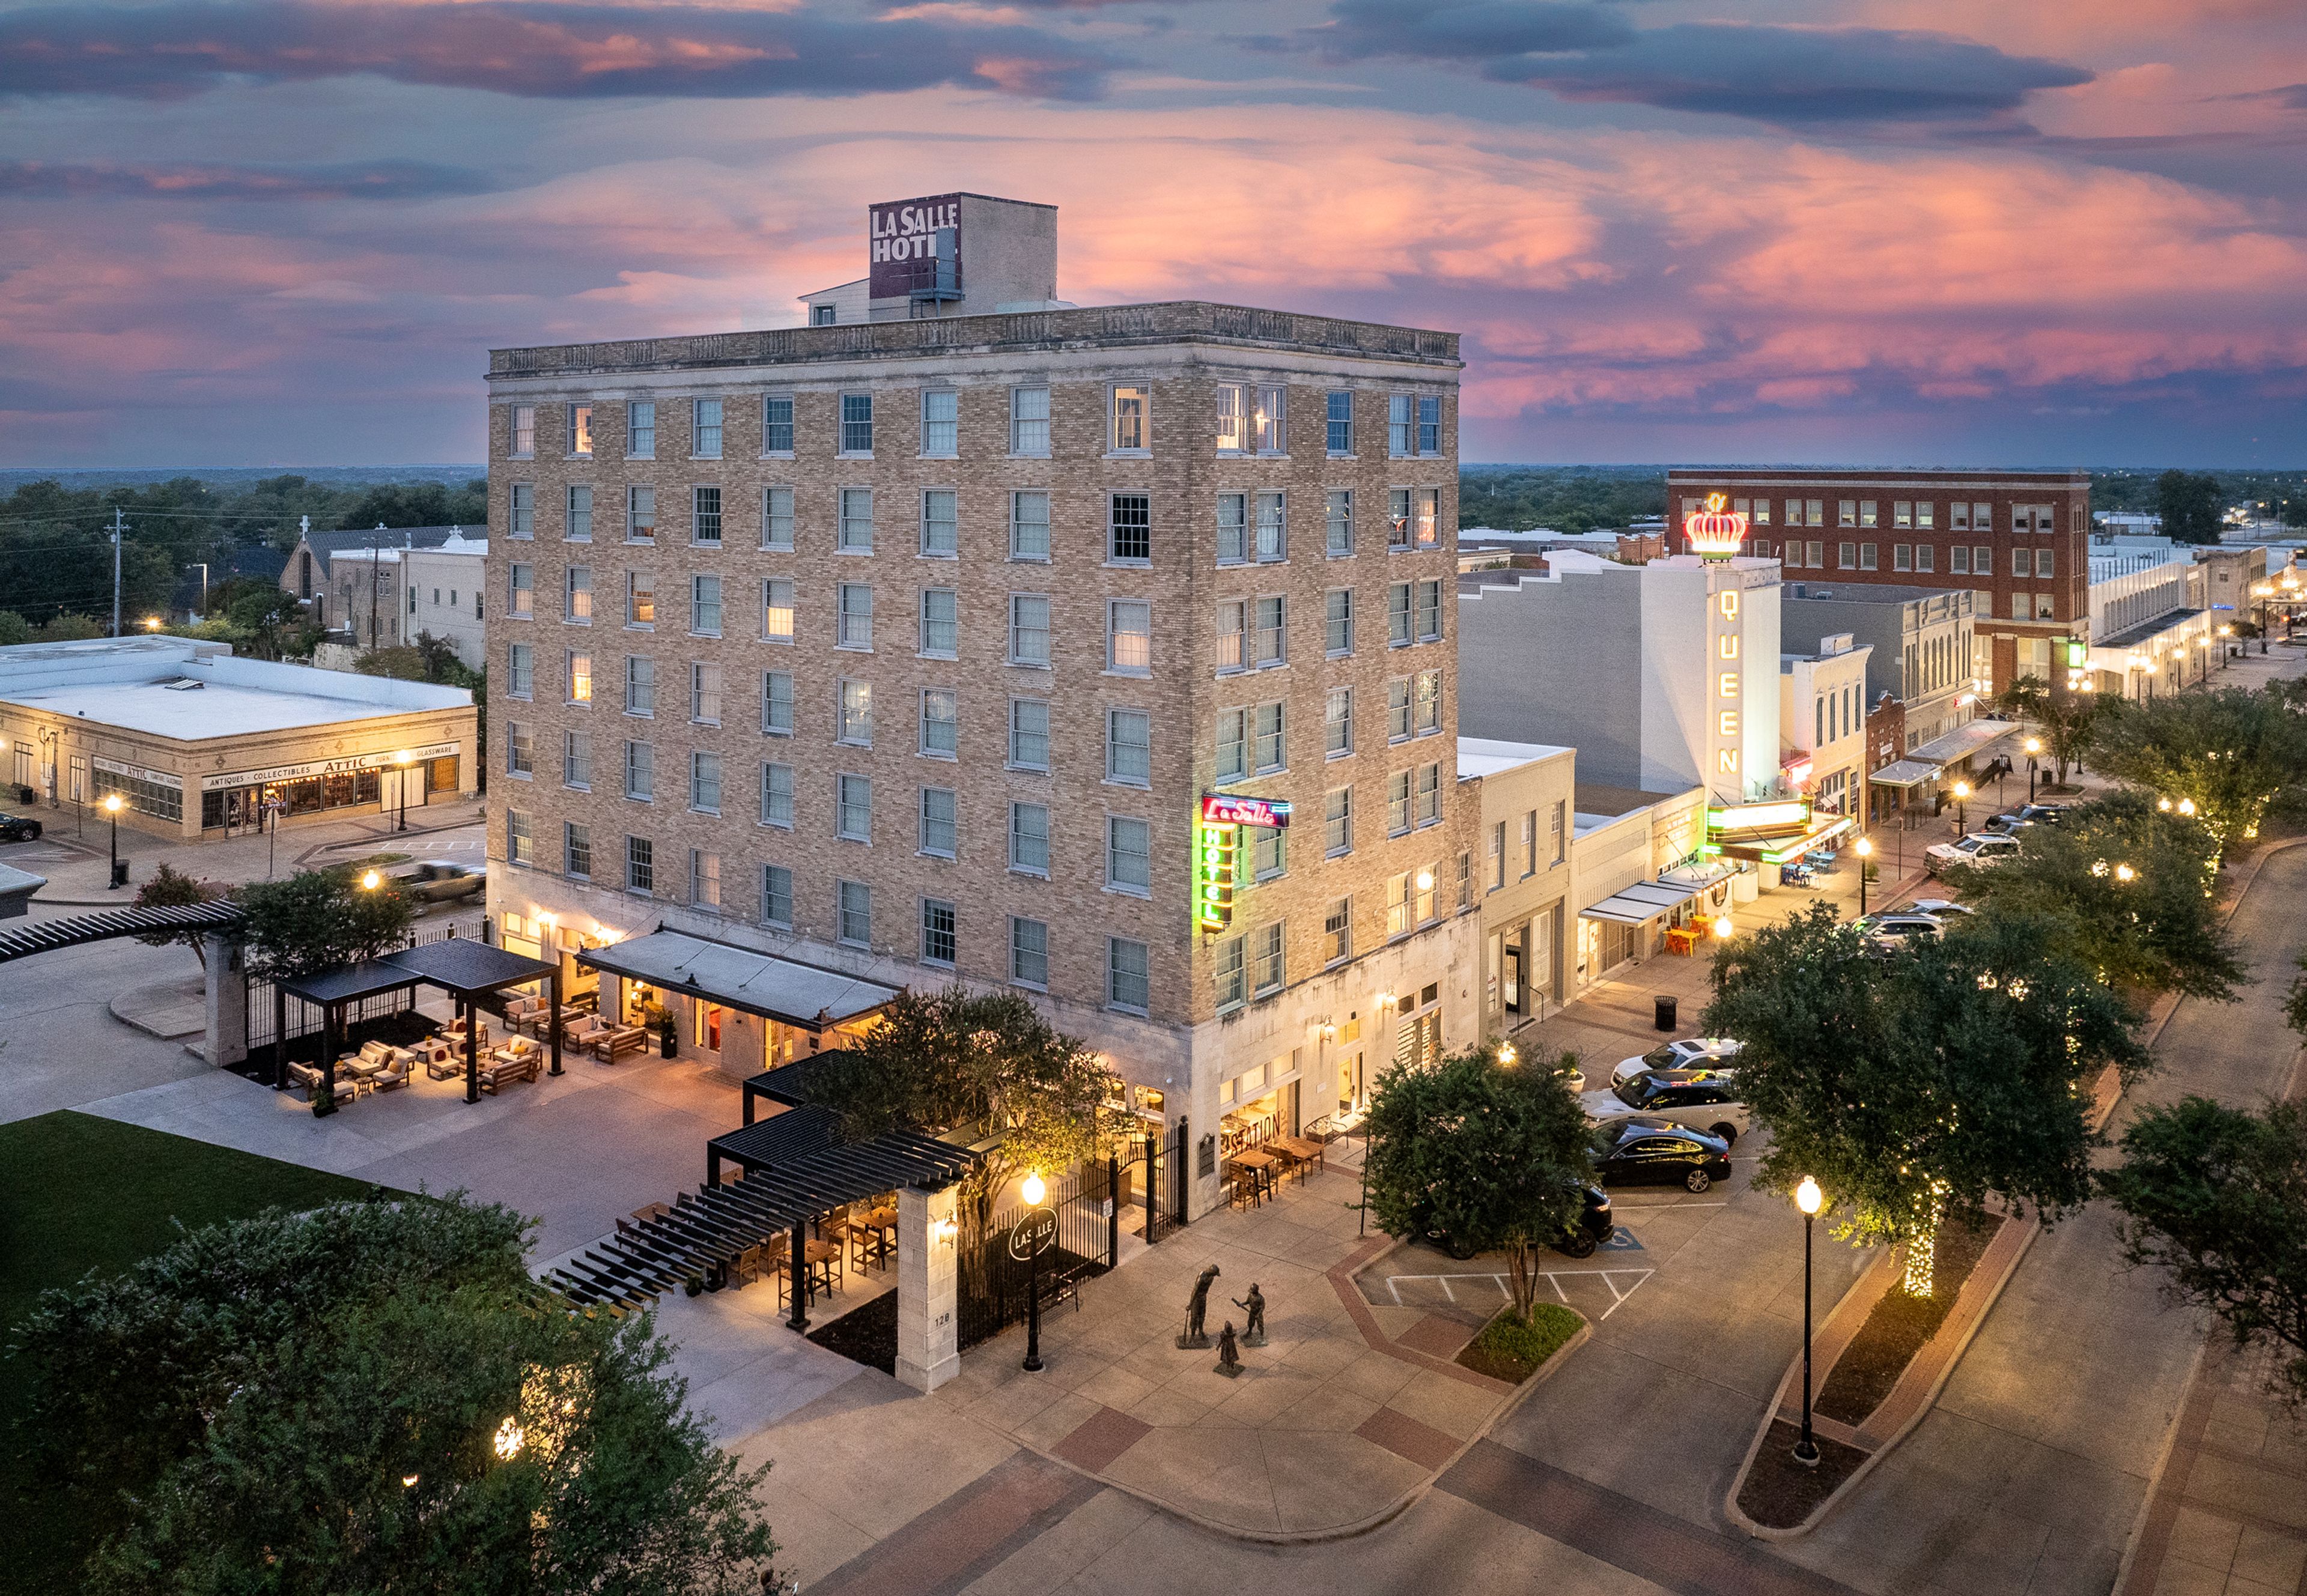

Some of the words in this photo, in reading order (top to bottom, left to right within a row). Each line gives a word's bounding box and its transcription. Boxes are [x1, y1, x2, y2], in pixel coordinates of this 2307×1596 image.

[1719, 589, 1739, 774] QUEEN
[127, 766, 147, 780] ATTIC
[210, 775, 244, 787] ANTIQUES
[254, 766, 311, 780] COLLECTIBLES
[324, 757, 366, 772] ATTIC
[418, 747, 452, 757] GLASSWARE
[1205, 829, 1220, 920] HOTEL
[1231, 1110, 1280, 1159] STATION
[1015, 1220, 1053, 1249] LASLLE
